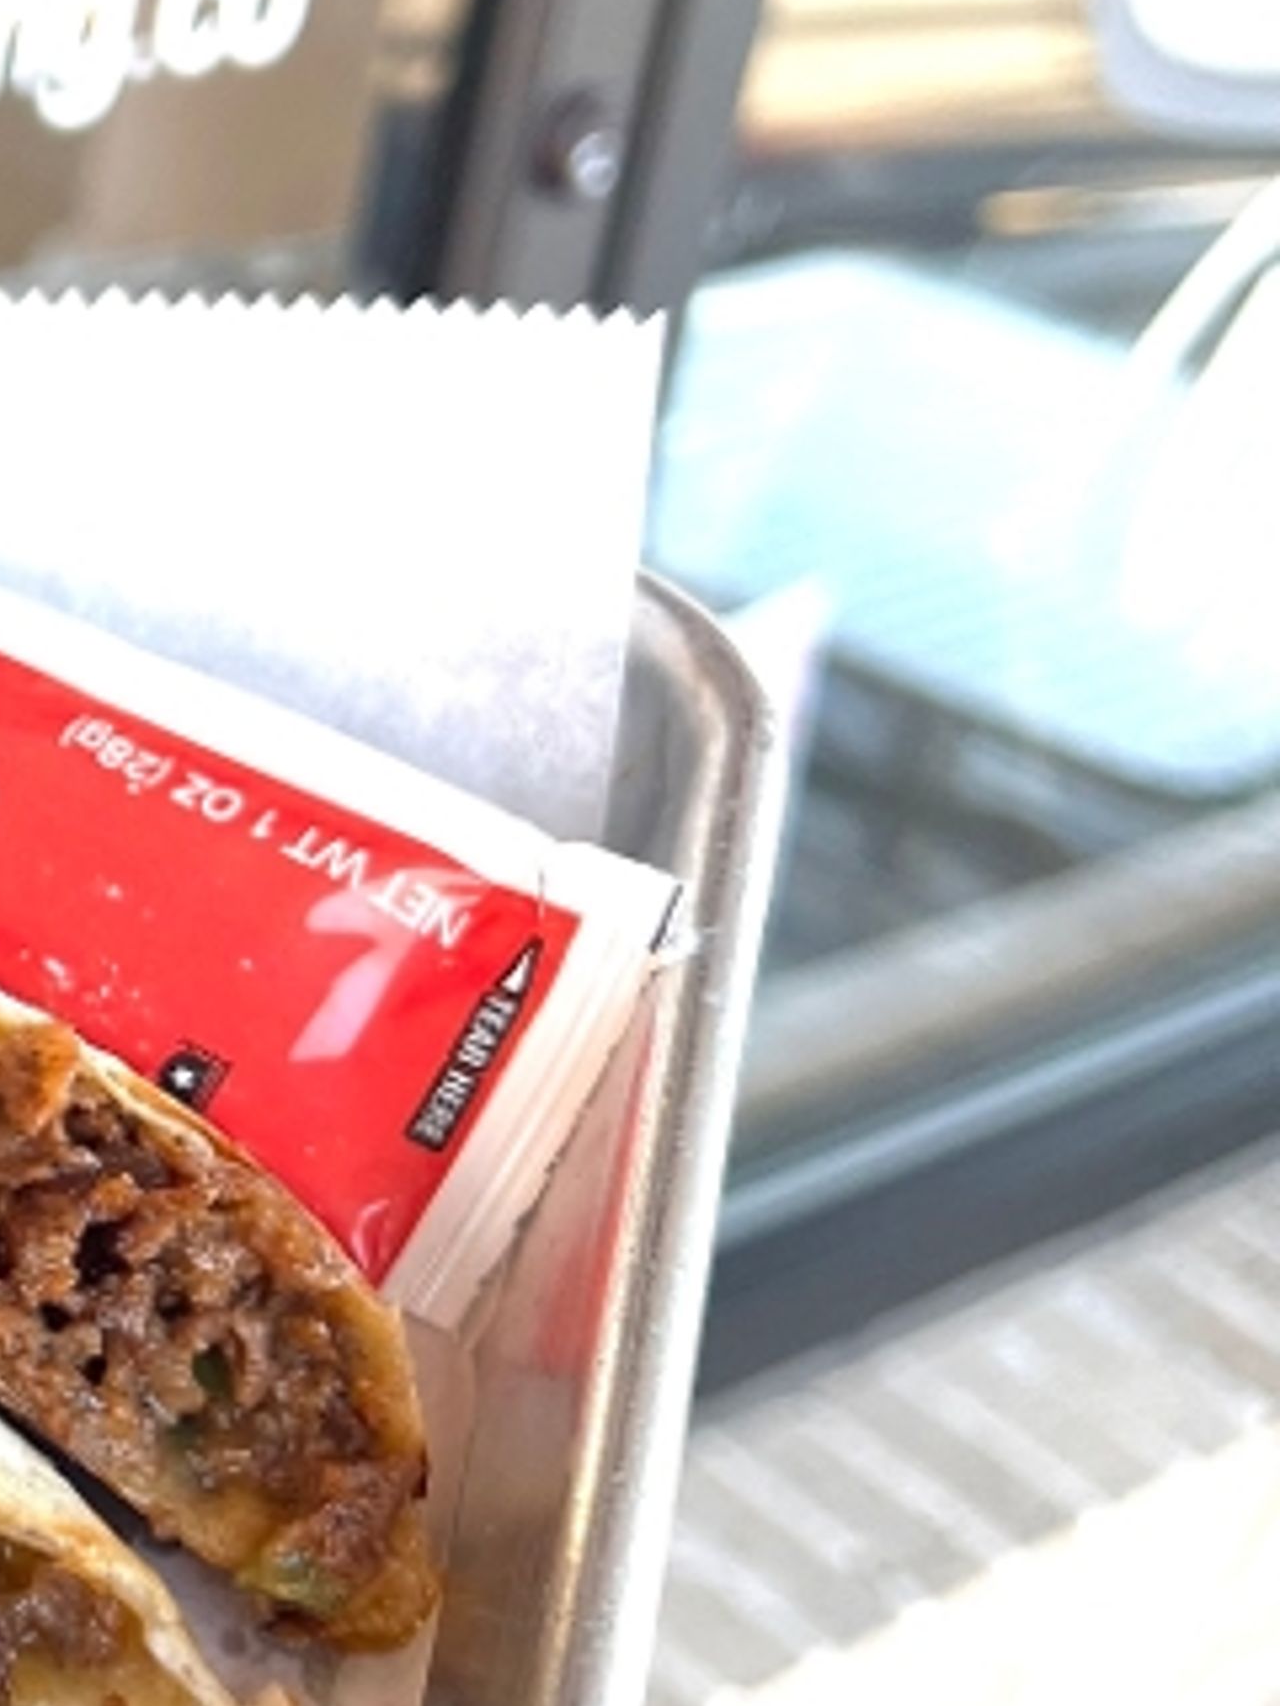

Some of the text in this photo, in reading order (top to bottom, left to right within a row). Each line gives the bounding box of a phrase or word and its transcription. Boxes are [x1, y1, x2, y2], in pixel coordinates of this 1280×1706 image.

[58, 715, 472, 950] NET WT 1 OZ (28g)
[412, 992, 519, 1144] TEAR HERE
